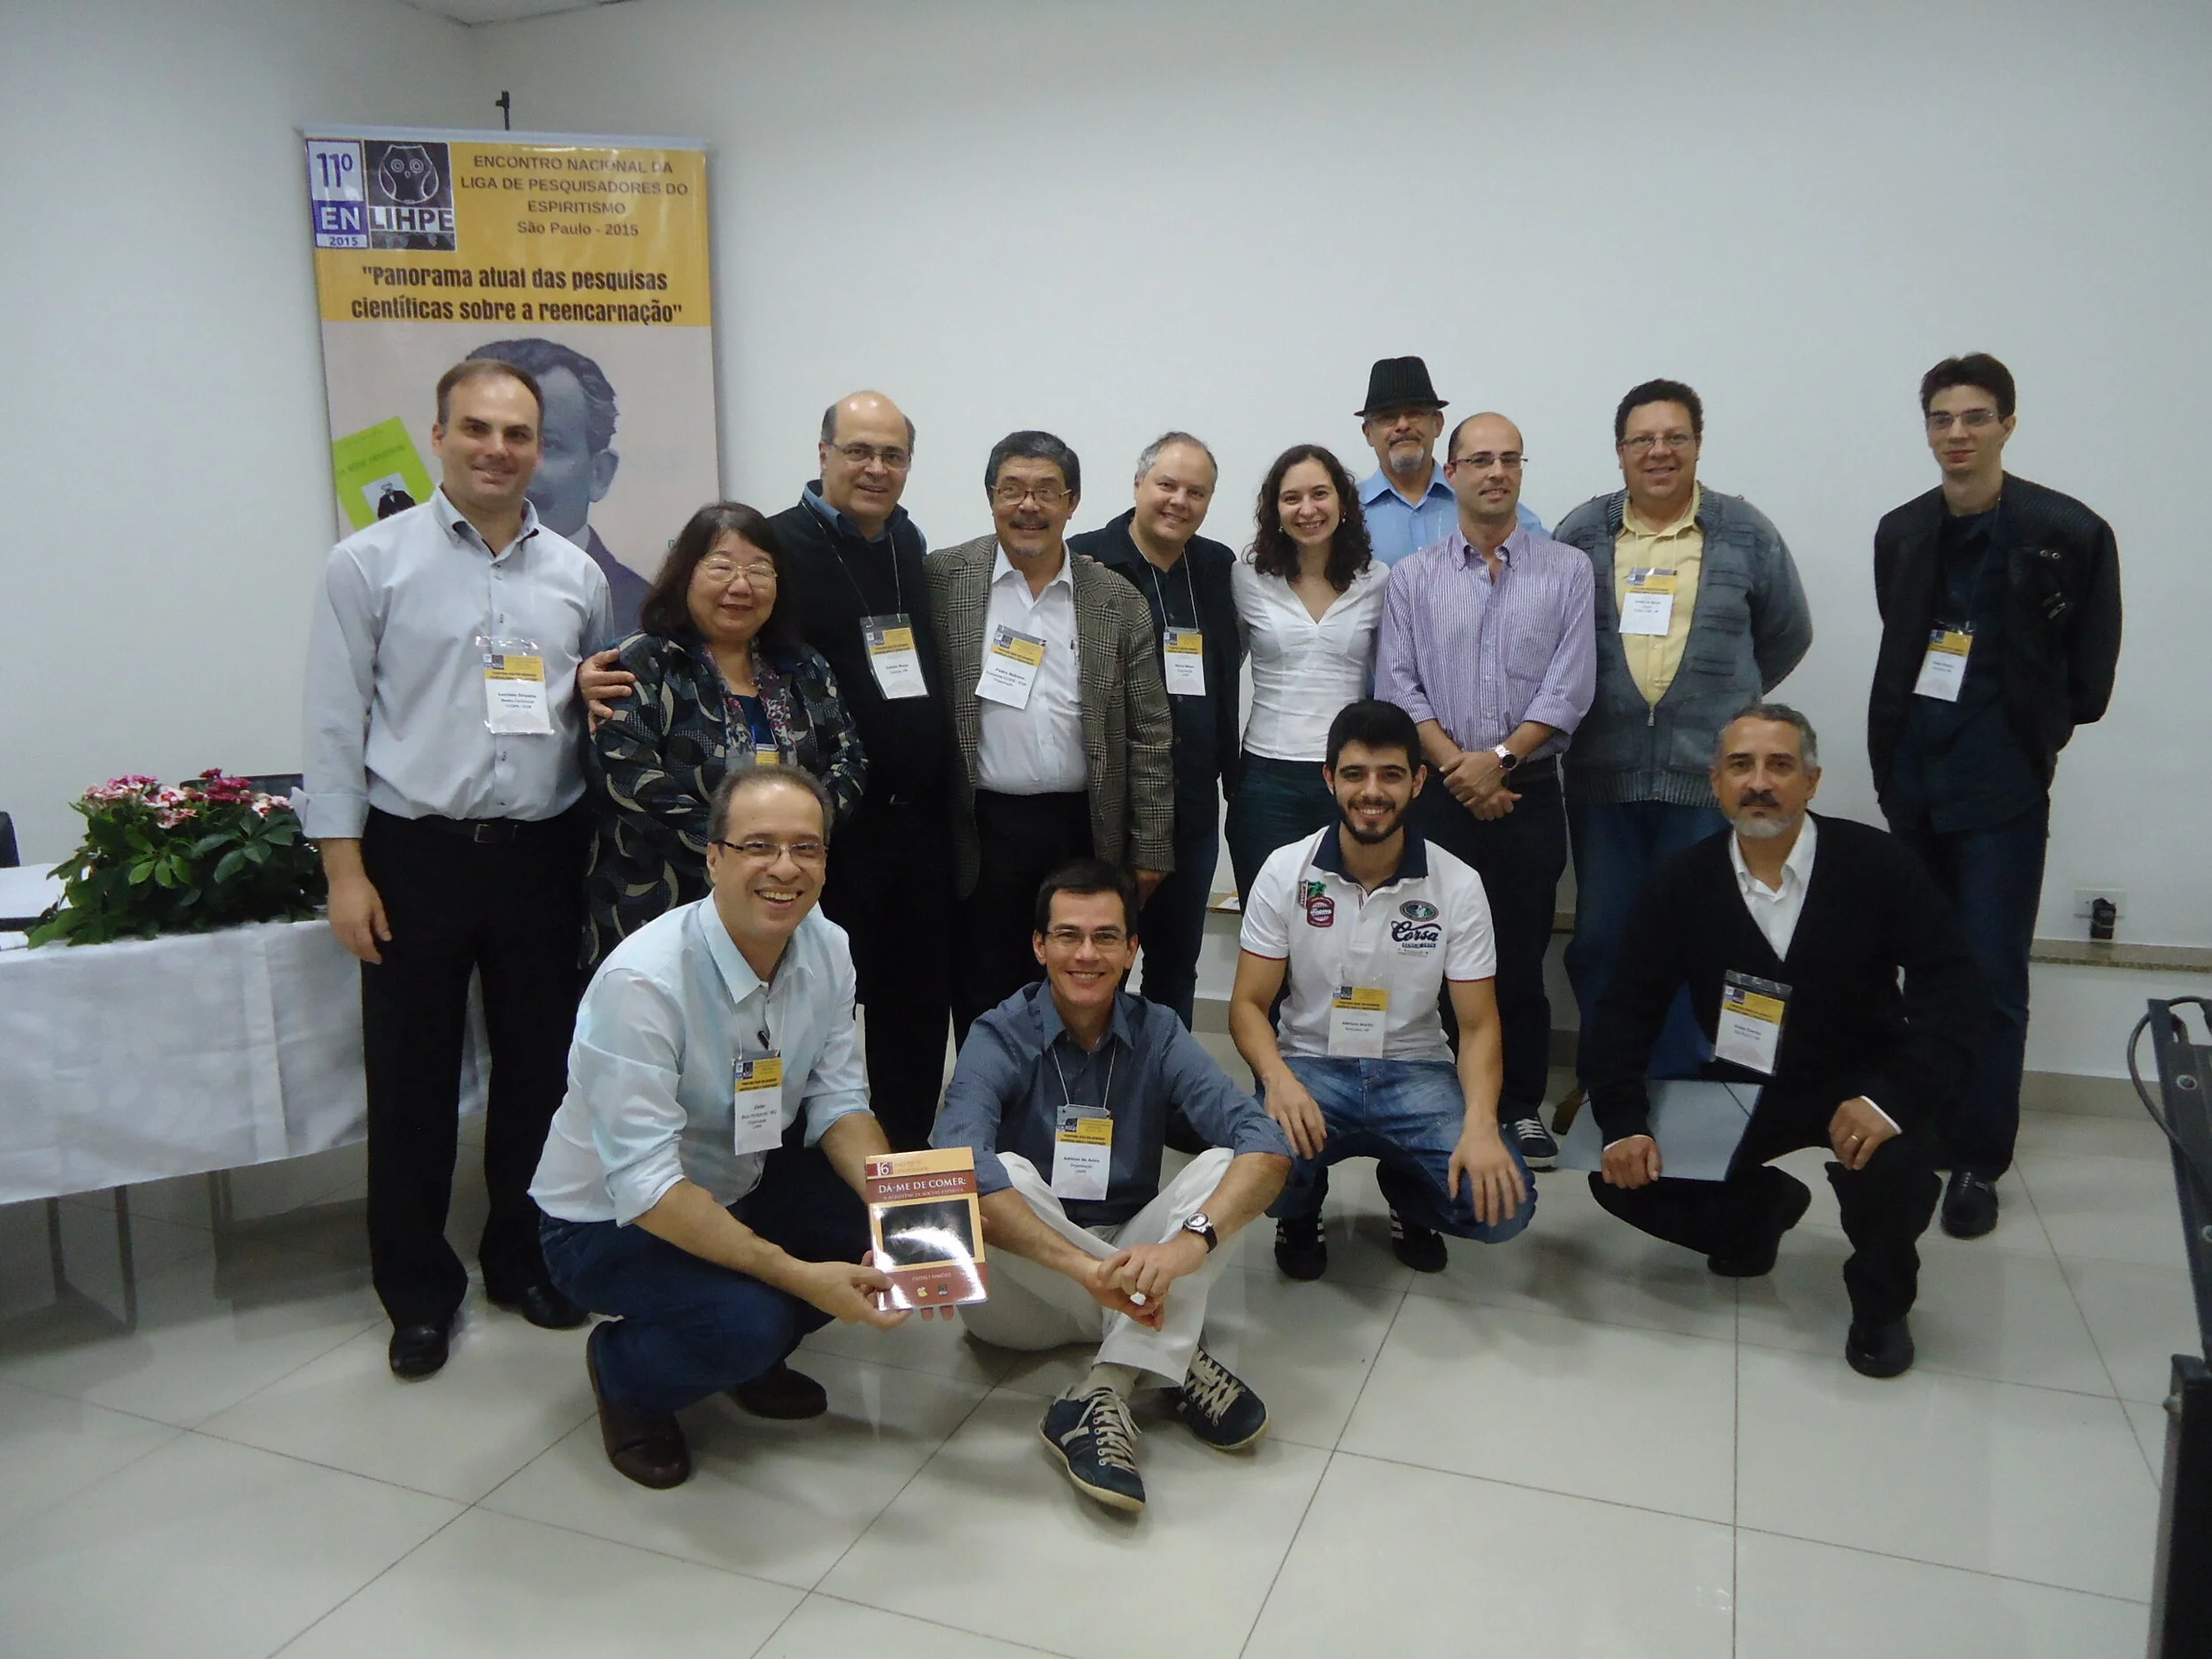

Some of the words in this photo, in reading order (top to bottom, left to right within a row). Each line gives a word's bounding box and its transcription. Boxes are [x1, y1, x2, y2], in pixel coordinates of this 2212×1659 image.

[473, 155, 563, 171] ENCONTRO
[567, 157, 648, 173] NACIONAL
[651, 161, 673, 174] DA
[460, 175, 497, 190] LIGA
[503, 178, 524, 191] DE
[528, 179, 662, 196] PESQUISADORES
[665, 183, 689, 196] DO
[527, 200, 626, 215] ESPIRITISMO
[320, 206, 362, 231] EN
[369, 207, 455, 232] LIHPE
[517, 221, 546, 234] São
[550, 222, 592, 236] Paulo
[605, 223, 640, 237] 2015
[329, 236, 358, 247] 2015
[362, 265, 473, 288] "Panorama
[479, 267, 526, 288] atual
[532, 268, 567, 289] das
[572, 270, 668, 292] pesquisas
[351, 295, 454, 320] científicas
[459, 298, 517, 320] sobre
[521, 303, 534, 320] a
[539, 299, 683, 326] reencarnação"
[1390, 920, 1442, 942] Corsa
[913, 1180, 927, 1190] DE
